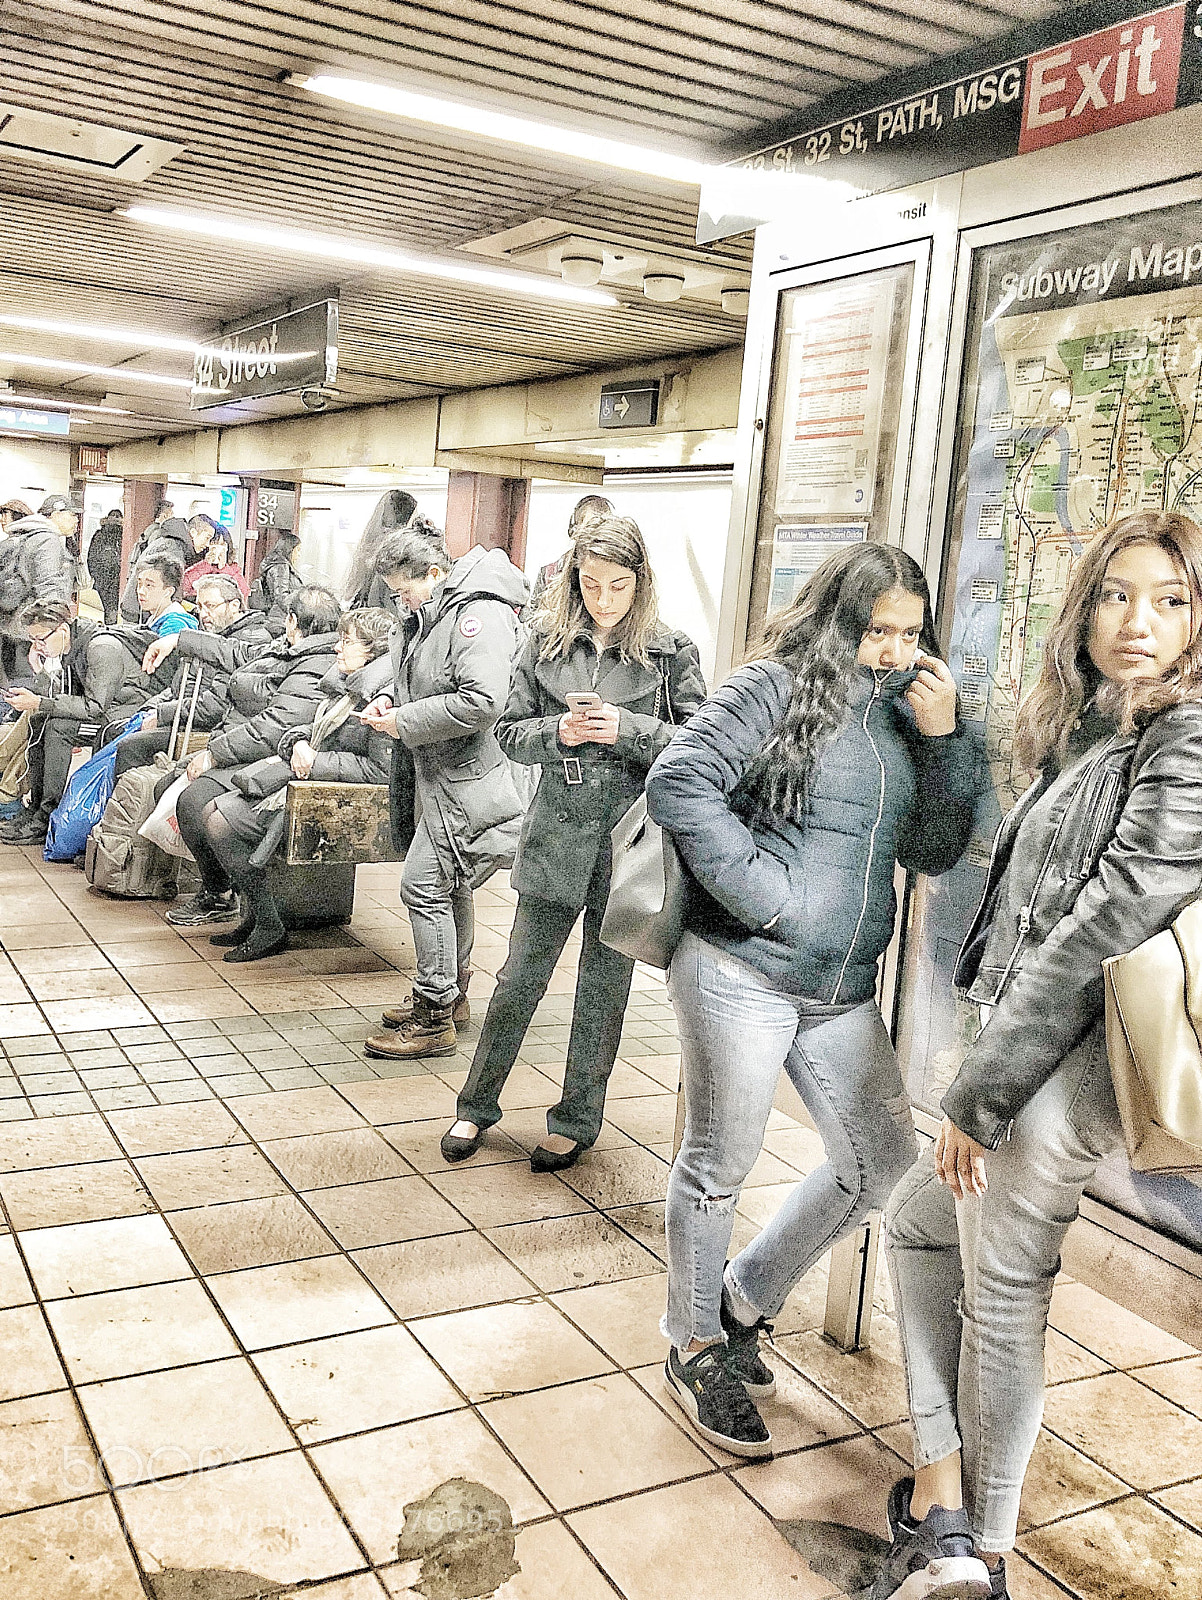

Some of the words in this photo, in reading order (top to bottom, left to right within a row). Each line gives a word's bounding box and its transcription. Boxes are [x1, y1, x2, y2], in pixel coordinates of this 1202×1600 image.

[1026, 24, 1163, 130] Exit
[804, 132, 832, 166] 32
[839, 121, 869, 155] St,
[876, 93, 943, 144] PATH,
[953, 67, 1022, 120] MSG
[897, 202, 927, 220] nsit
[1000, 257, 1120, 301] Subway
[1127, 240, 1202, 283] Map
[218, 323, 280, 390] Street
[257, 508, 276, 526] St
[258, 493, 279, 510] 34
